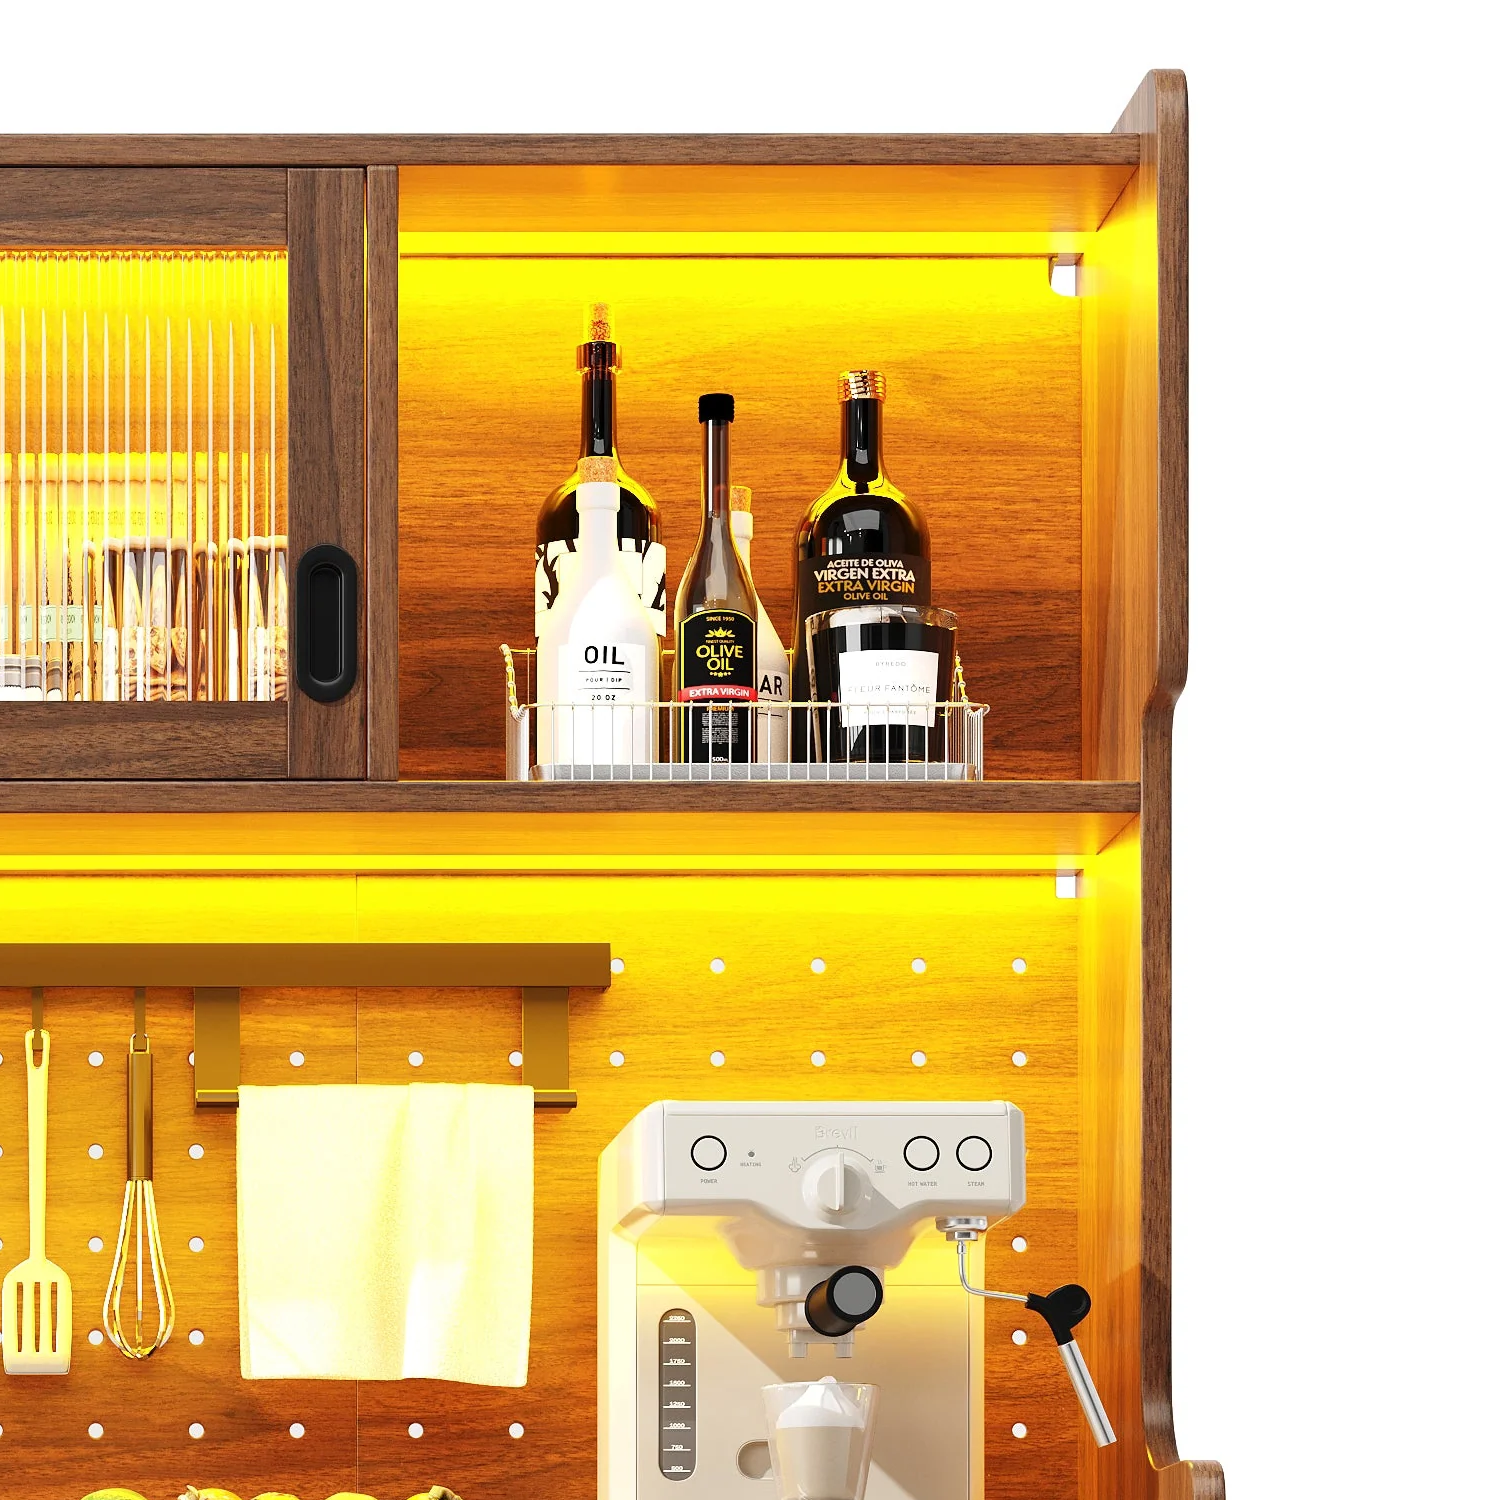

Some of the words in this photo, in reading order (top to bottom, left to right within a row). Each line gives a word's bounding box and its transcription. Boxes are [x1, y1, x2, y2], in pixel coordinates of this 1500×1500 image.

[827, 559, 859, 569] ACEITE
[861, 559, 873, 567] DE
[876, 559, 904, 568] OLIVA
[814, 568, 869, 582] VIRGEN
[872, 568, 916, 582] EXTRA
[818, 581, 863, 593] EXTRA
[867, 580, 915, 594] VIRGIN
[844, 593, 871, 601] OLIVE
[873, 593, 889, 601] OIL
[585, 645, 624, 665] OIL
[696, 645, 743, 658] OLIVE
[707, 658, 734, 671] OIL
[759, 674, 783, 696] AR
[689, 687, 720, 698] EXTRA
[720, 687, 750, 697] VIRGIN
